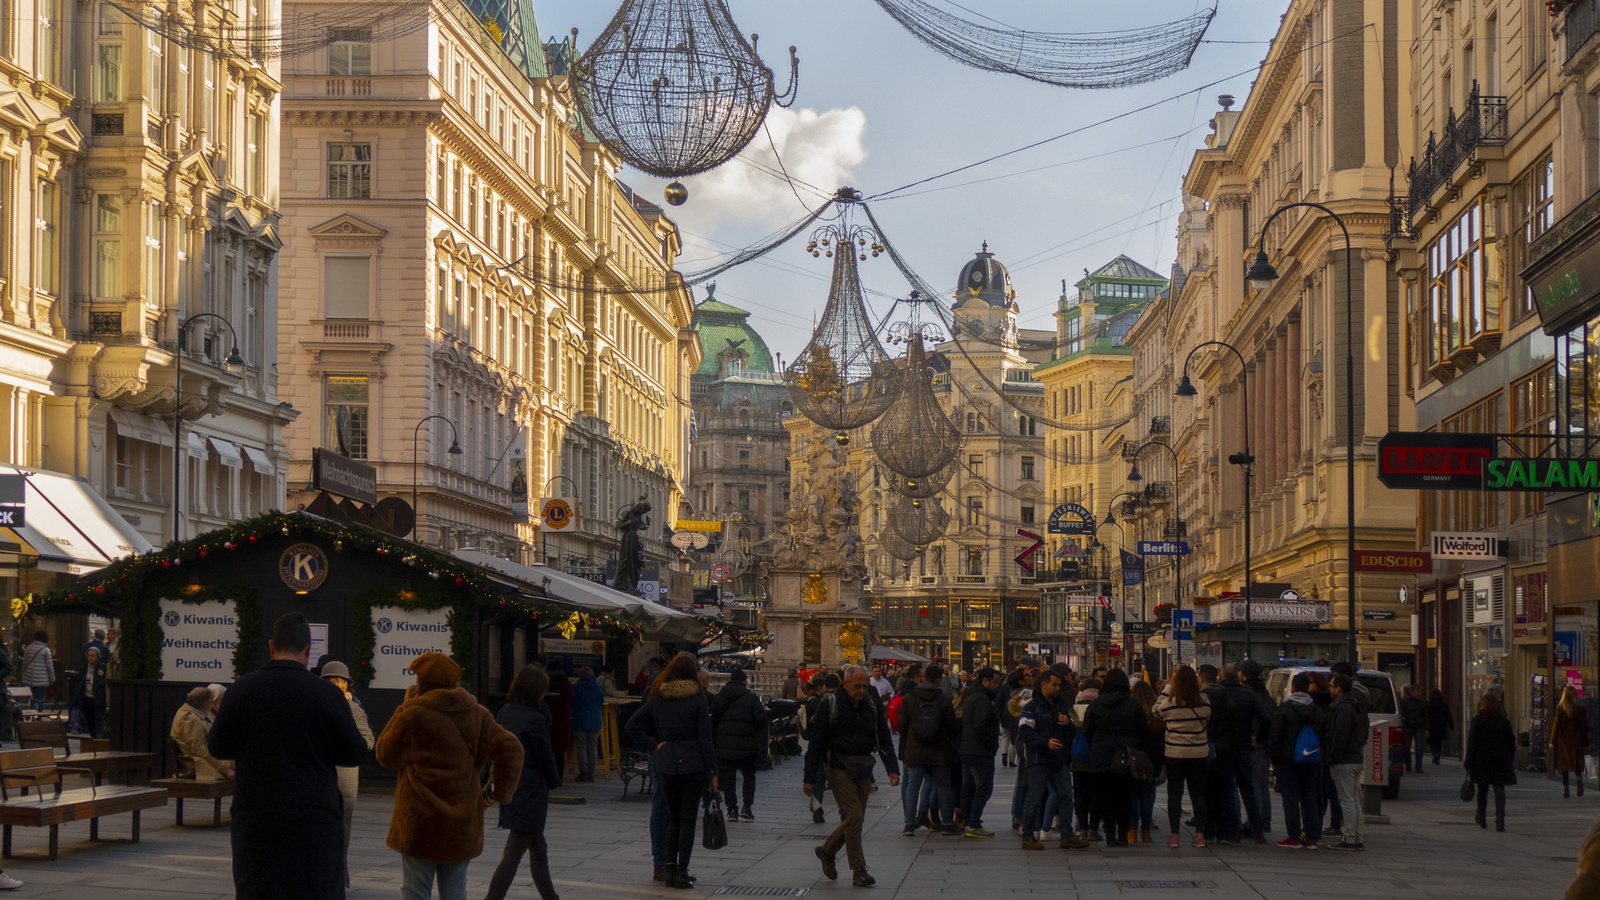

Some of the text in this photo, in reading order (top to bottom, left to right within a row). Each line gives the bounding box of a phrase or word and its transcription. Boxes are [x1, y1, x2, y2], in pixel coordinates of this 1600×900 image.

[1388, 450, 1486, 471] LLOYD
[321, 458, 376, 494] Weihnachtspunsch
[1487, 460, 1600, 488] SALAM
[1445, 541, 1485, 551] Wolford
[289, 546, 319, 558] KIWANIS
[1361, 555, 1424, 568] EDUSCHO
[1249, 605, 1314, 616] SOUVENIRS
[183, 614, 234, 625] Kiwanis
[396, 621, 448, 633] Kiwanis
[161, 638, 237, 649] Weihnachts
[176, 659, 222, 669] Punsch
[402, 668, 415, 676] ro
